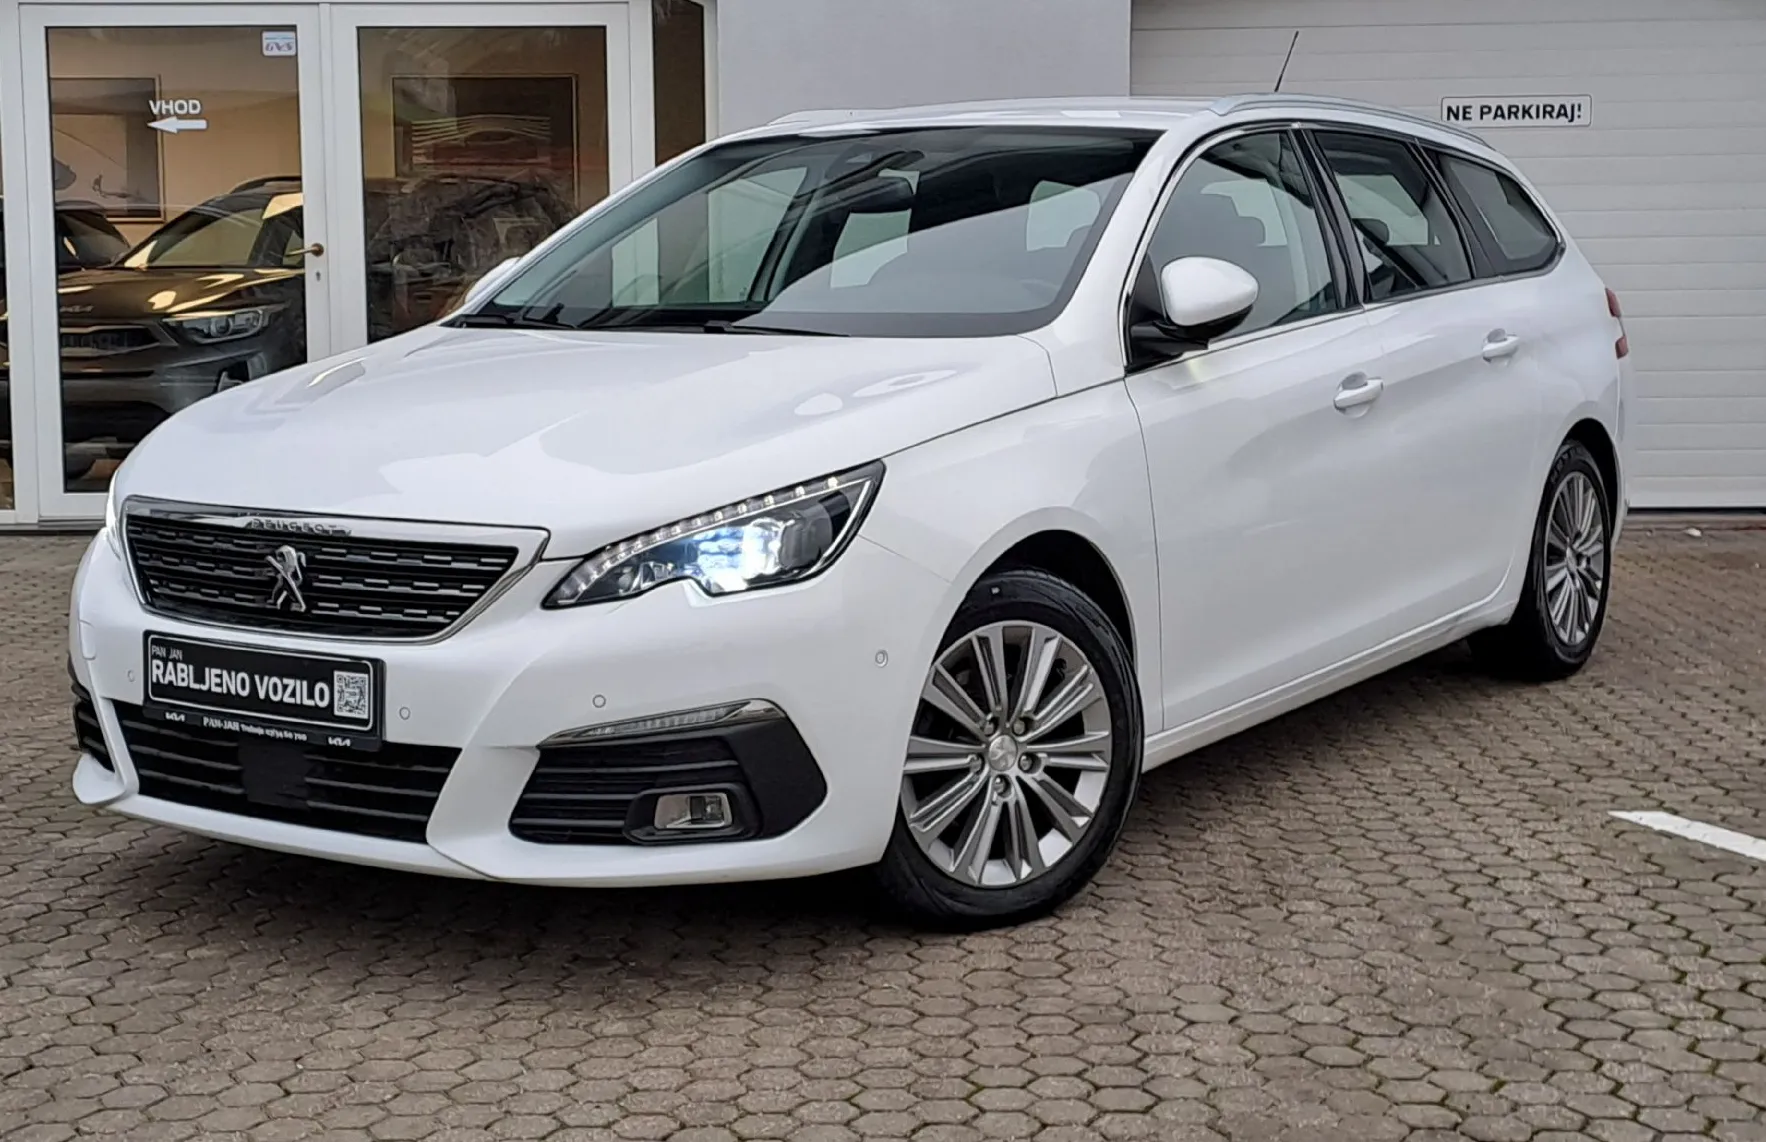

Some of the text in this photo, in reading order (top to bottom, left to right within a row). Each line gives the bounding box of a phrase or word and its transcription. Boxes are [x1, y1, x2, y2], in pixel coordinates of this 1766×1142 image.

[149, 99, 201, 115] VHOD
[1446, 103, 1582, 123] NE PARKIRAJ!
[251, 519, 338, 535] PEUGEOT
[151, 645, 183, 660] PAN JAN
[151, 659, 330, 708] RABLJENO VOZILO
